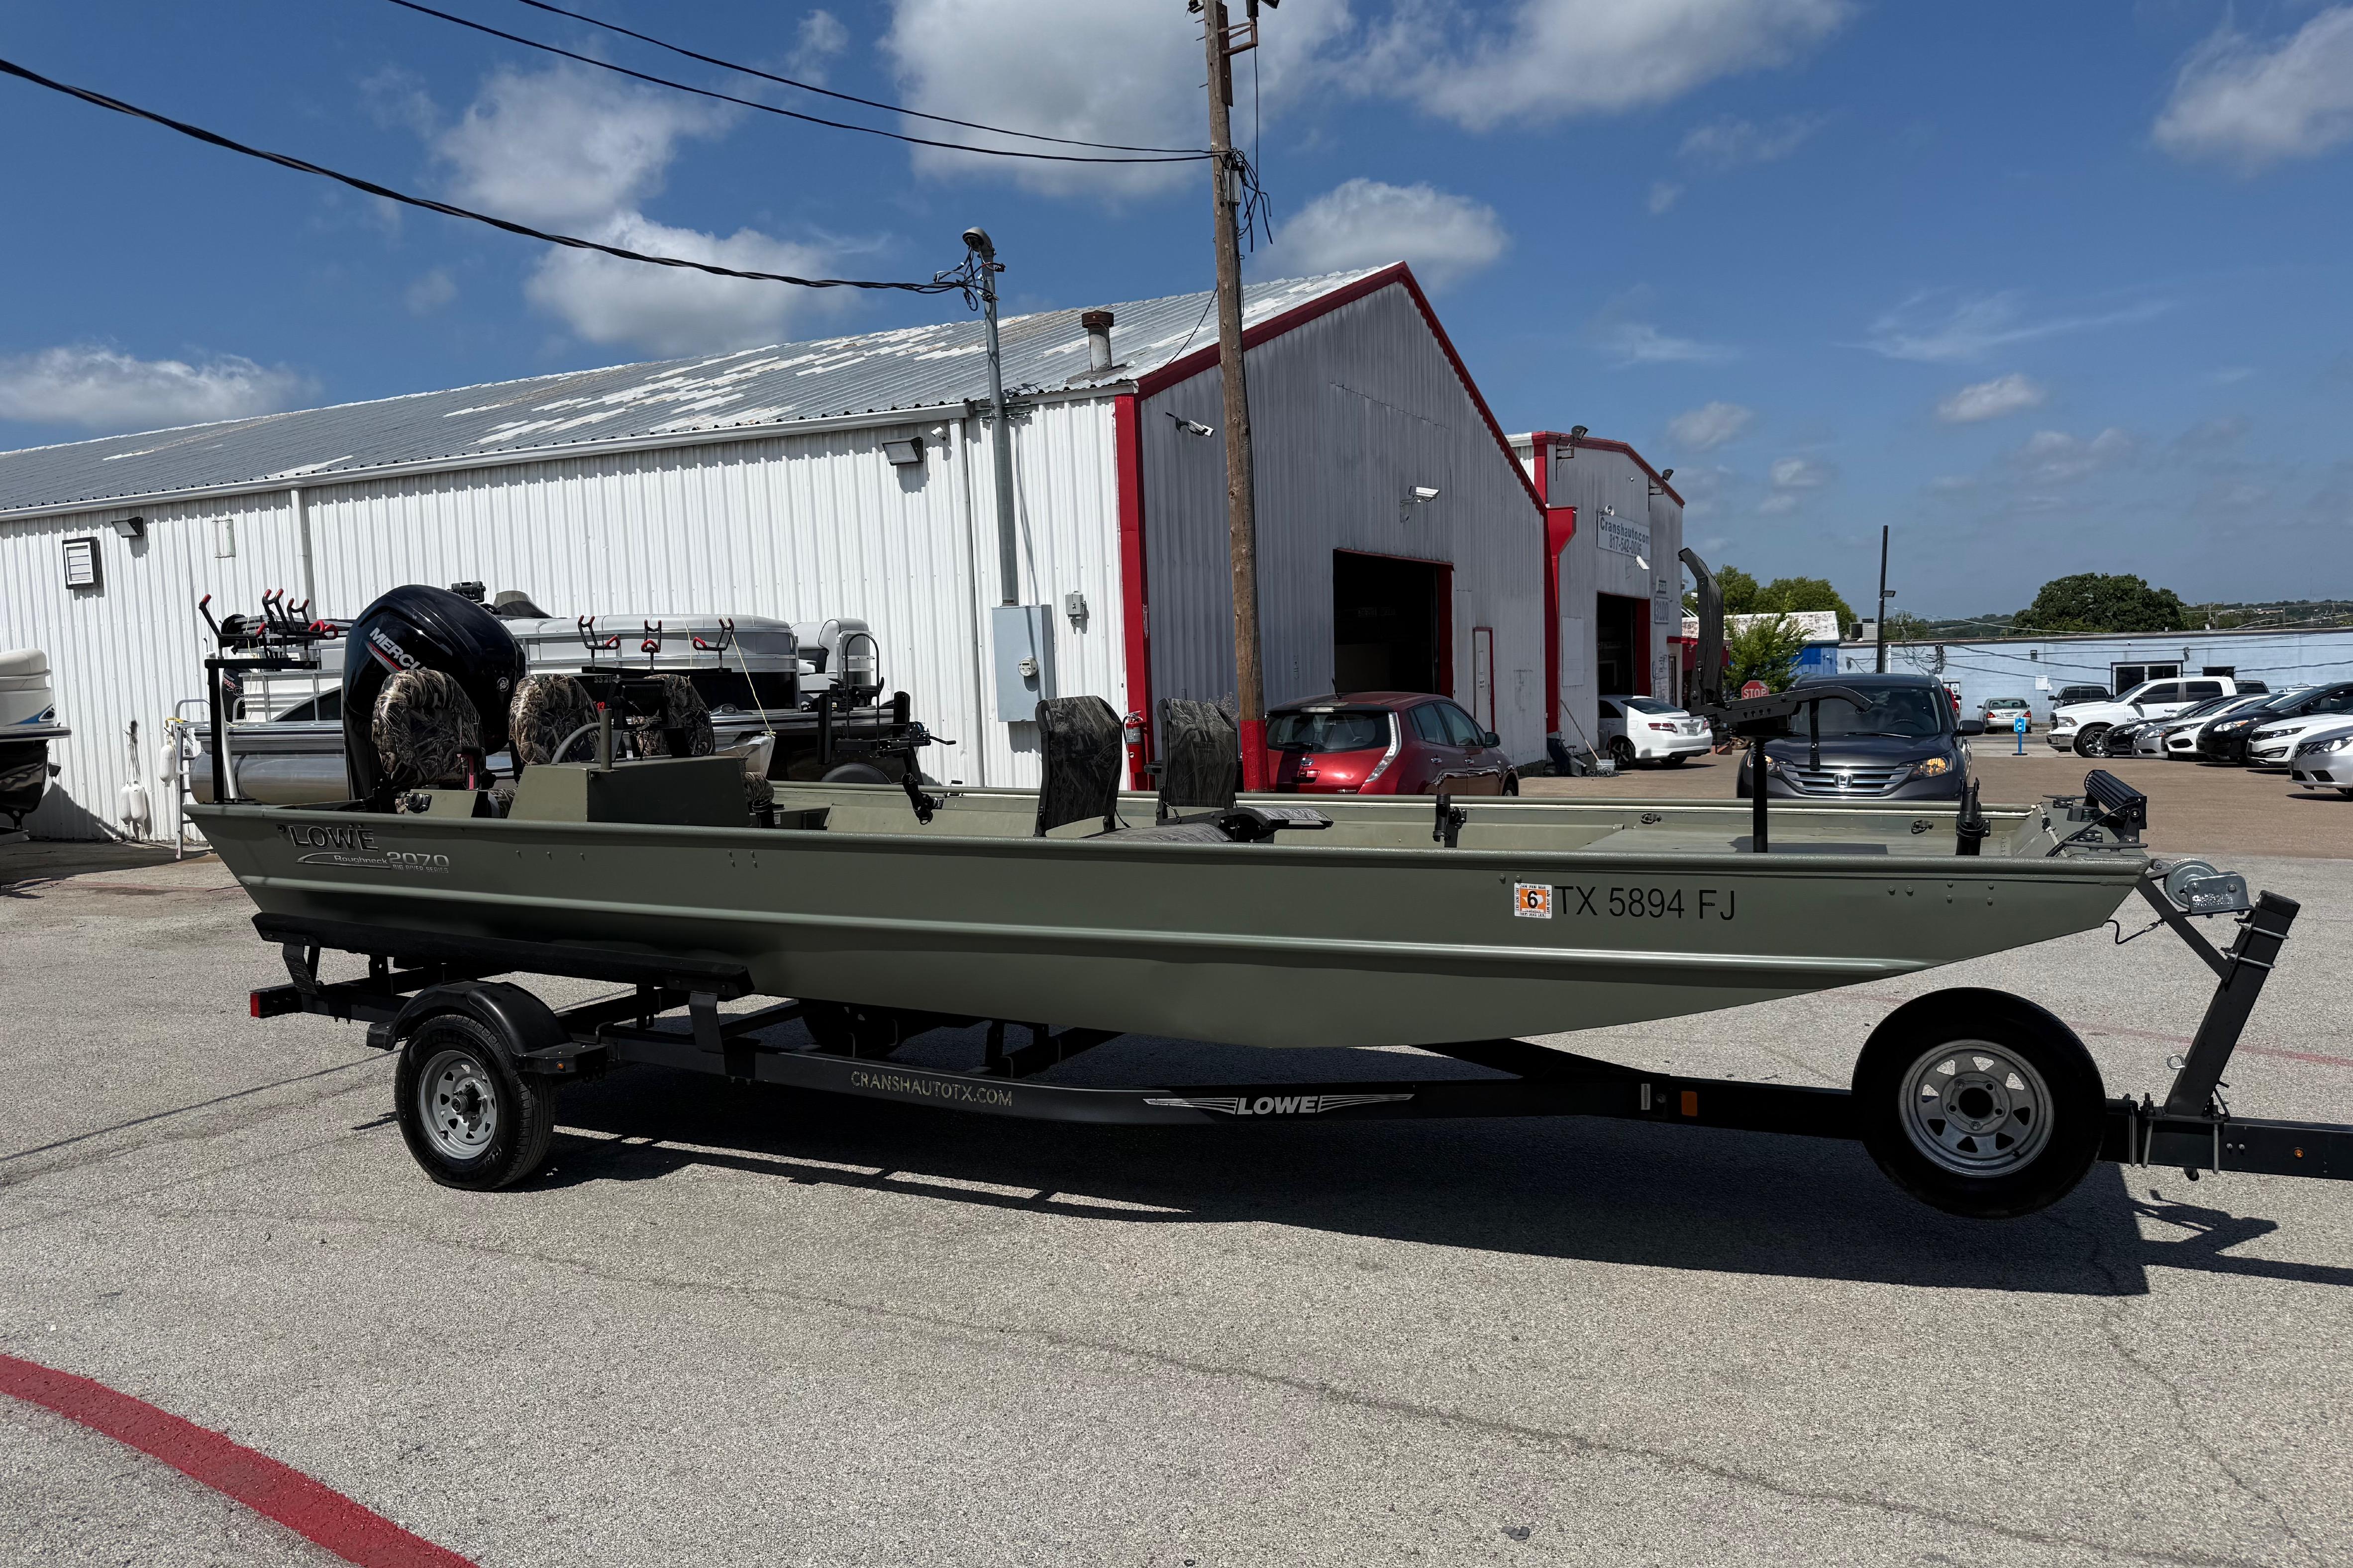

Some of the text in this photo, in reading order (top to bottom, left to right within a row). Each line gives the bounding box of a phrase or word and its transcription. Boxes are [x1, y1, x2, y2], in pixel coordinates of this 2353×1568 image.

[1743, 688, 1766, 698] STOP
[288, 826, 379, 852] LOWE
[334, 852, 450, 867] Roughneck 2070
[1528, 890, 1538, 909] 6
[1554, 886, 1598, 915] TX
[1609, 887, 1685, 918] 5894
[1699, 889, 1735, 920] FJ
[851, 1071, 1012, 1106] CRANSHAUTOTX.COM
[1237, 1096, 1318, 1115] LOWE
